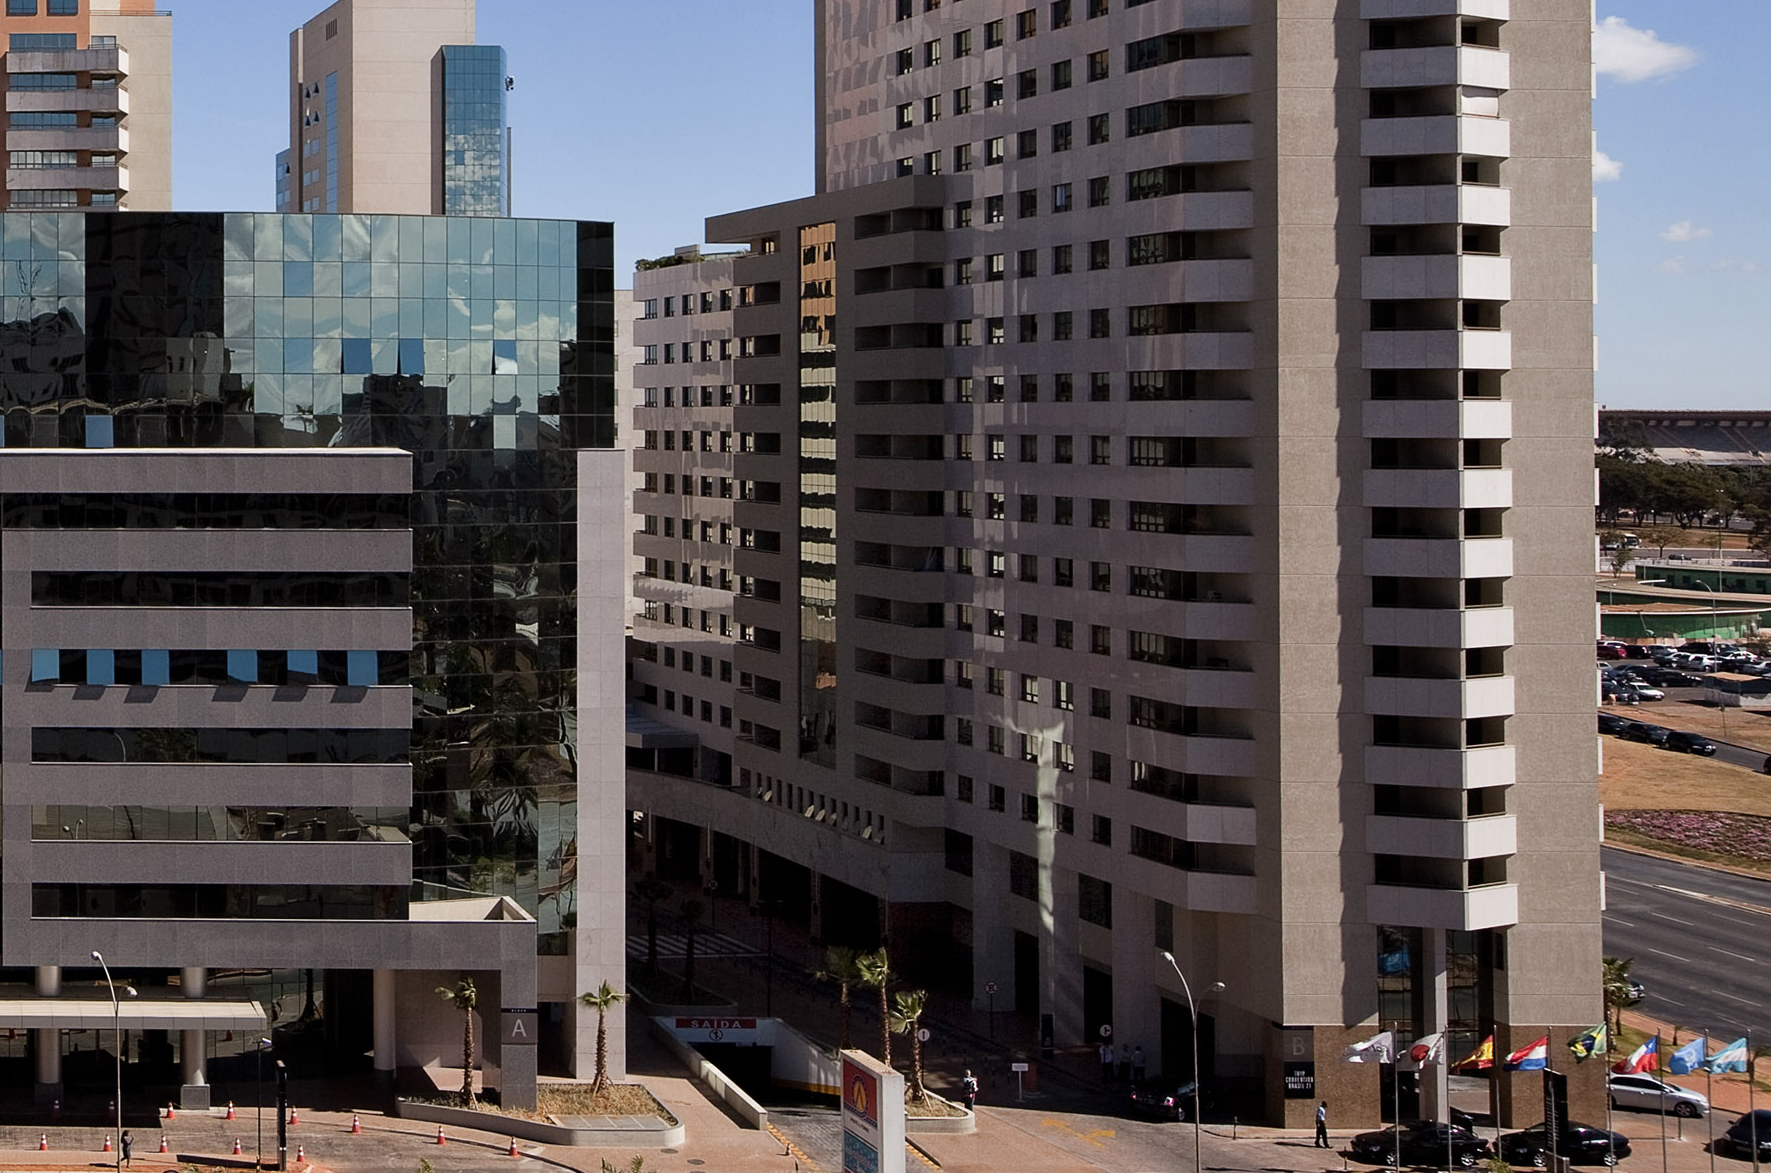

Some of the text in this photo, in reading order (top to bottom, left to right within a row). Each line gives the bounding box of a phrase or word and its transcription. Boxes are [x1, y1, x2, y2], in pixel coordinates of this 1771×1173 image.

[511, 1019, 527, 1037] A
[691, 1018, 742, 1029] SAÍDA
[1292, 1036, 1306, 1056] B
